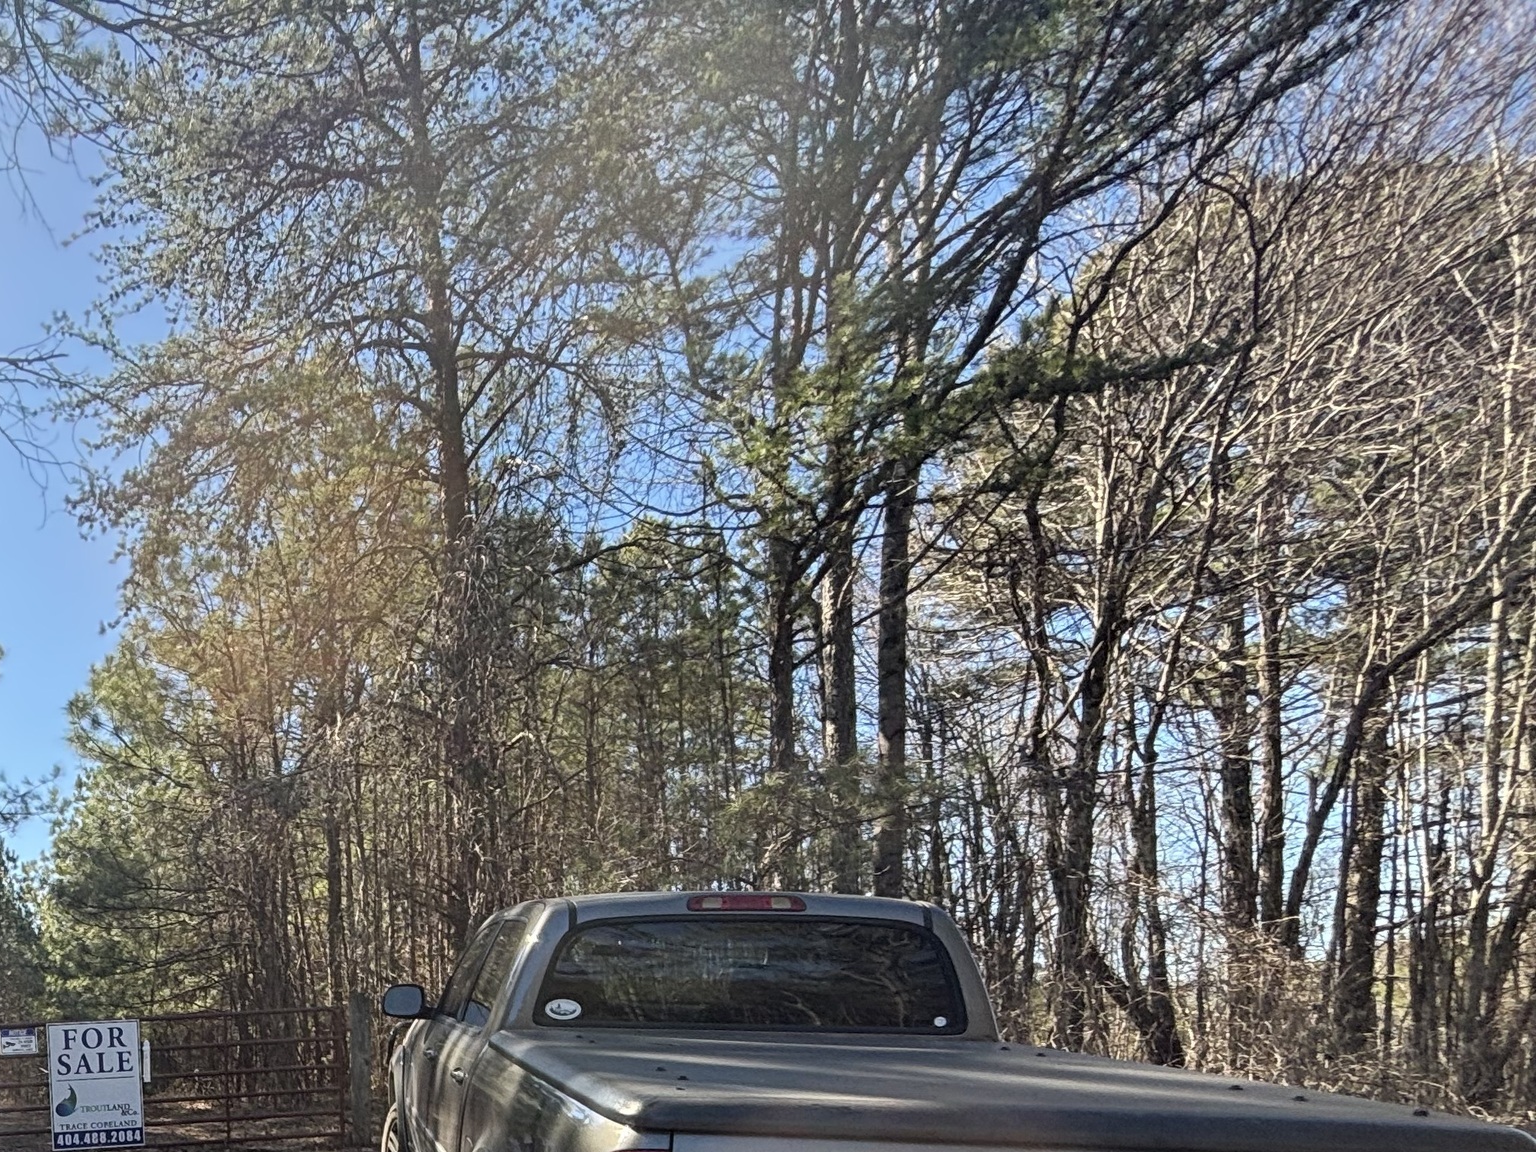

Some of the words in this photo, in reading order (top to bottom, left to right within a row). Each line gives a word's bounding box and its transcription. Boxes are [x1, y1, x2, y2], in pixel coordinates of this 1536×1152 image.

[62, 1027, 127, 1050] FOR
[57, 1051, 134, 1076] SALE
[80, 1103, 130, 1113] TROUTLAND
[59, 1123, 89, 1131] TRACE
[90, 1119, 137, 1129] COPELAND
